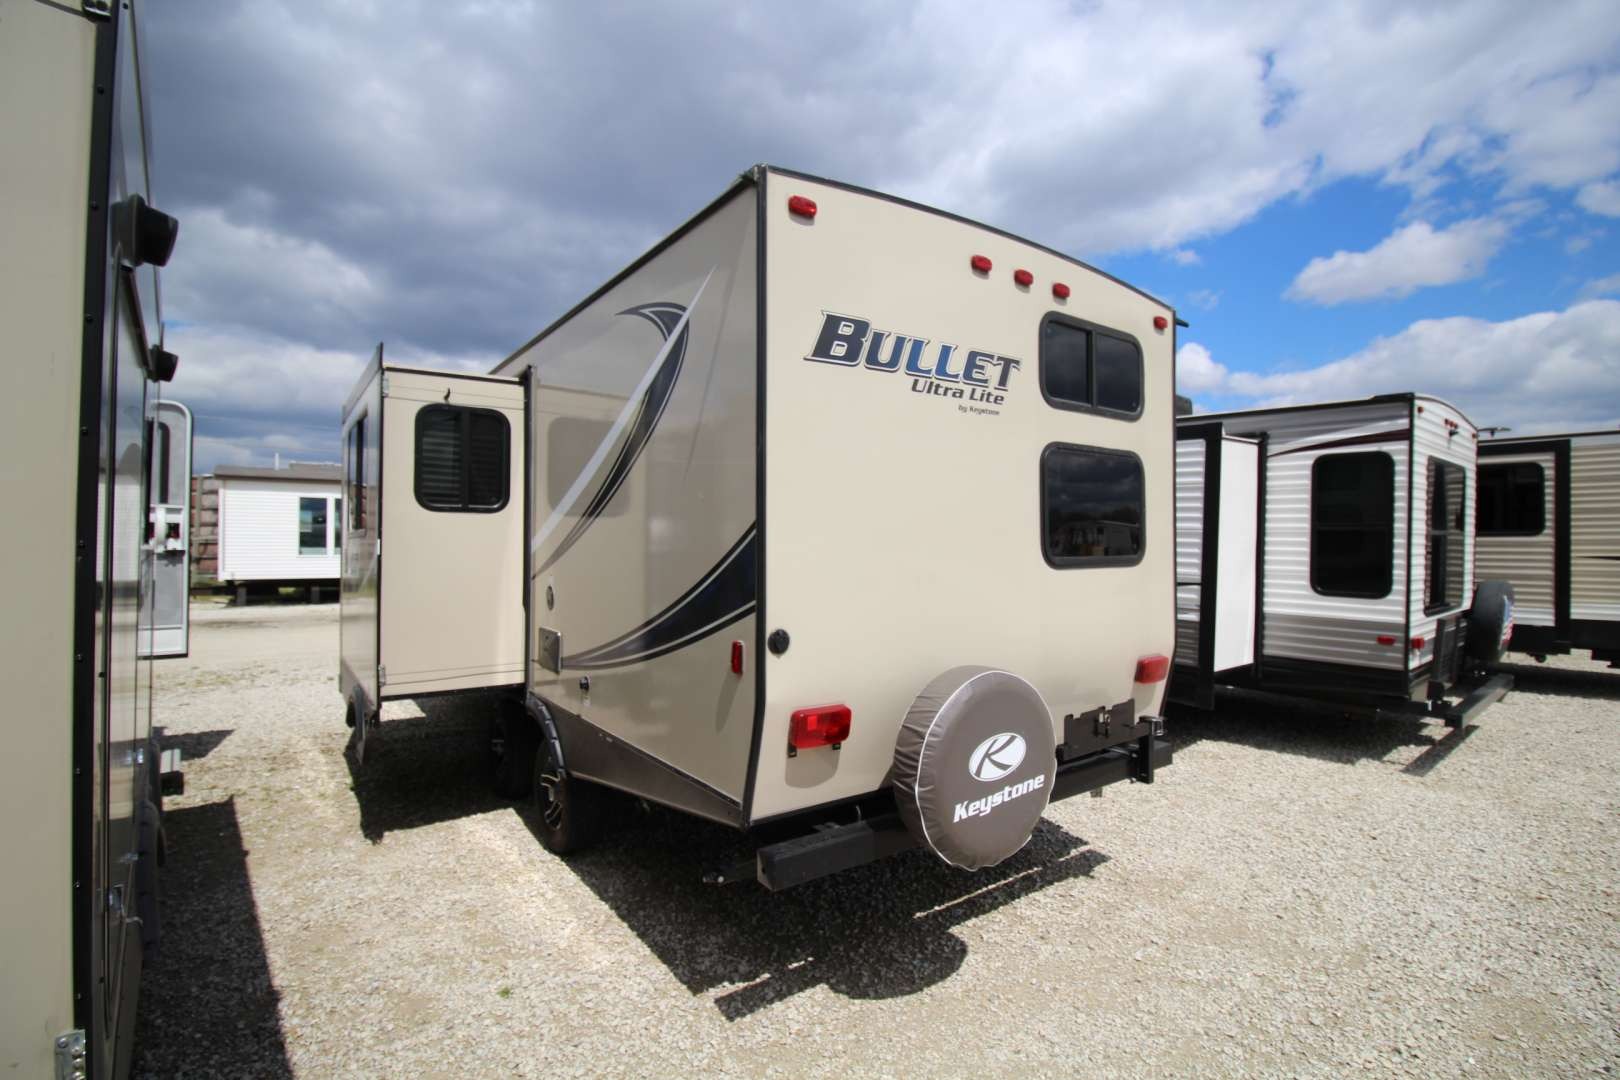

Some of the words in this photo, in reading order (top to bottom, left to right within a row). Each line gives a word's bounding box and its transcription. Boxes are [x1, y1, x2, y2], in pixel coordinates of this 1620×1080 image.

[803, 310, 1021, 391] BULLET
[911, 378, 964, 399] Ultra
[969, 388, 1004, 405] Lite
[953, 774, 1045, 823] Keystone
